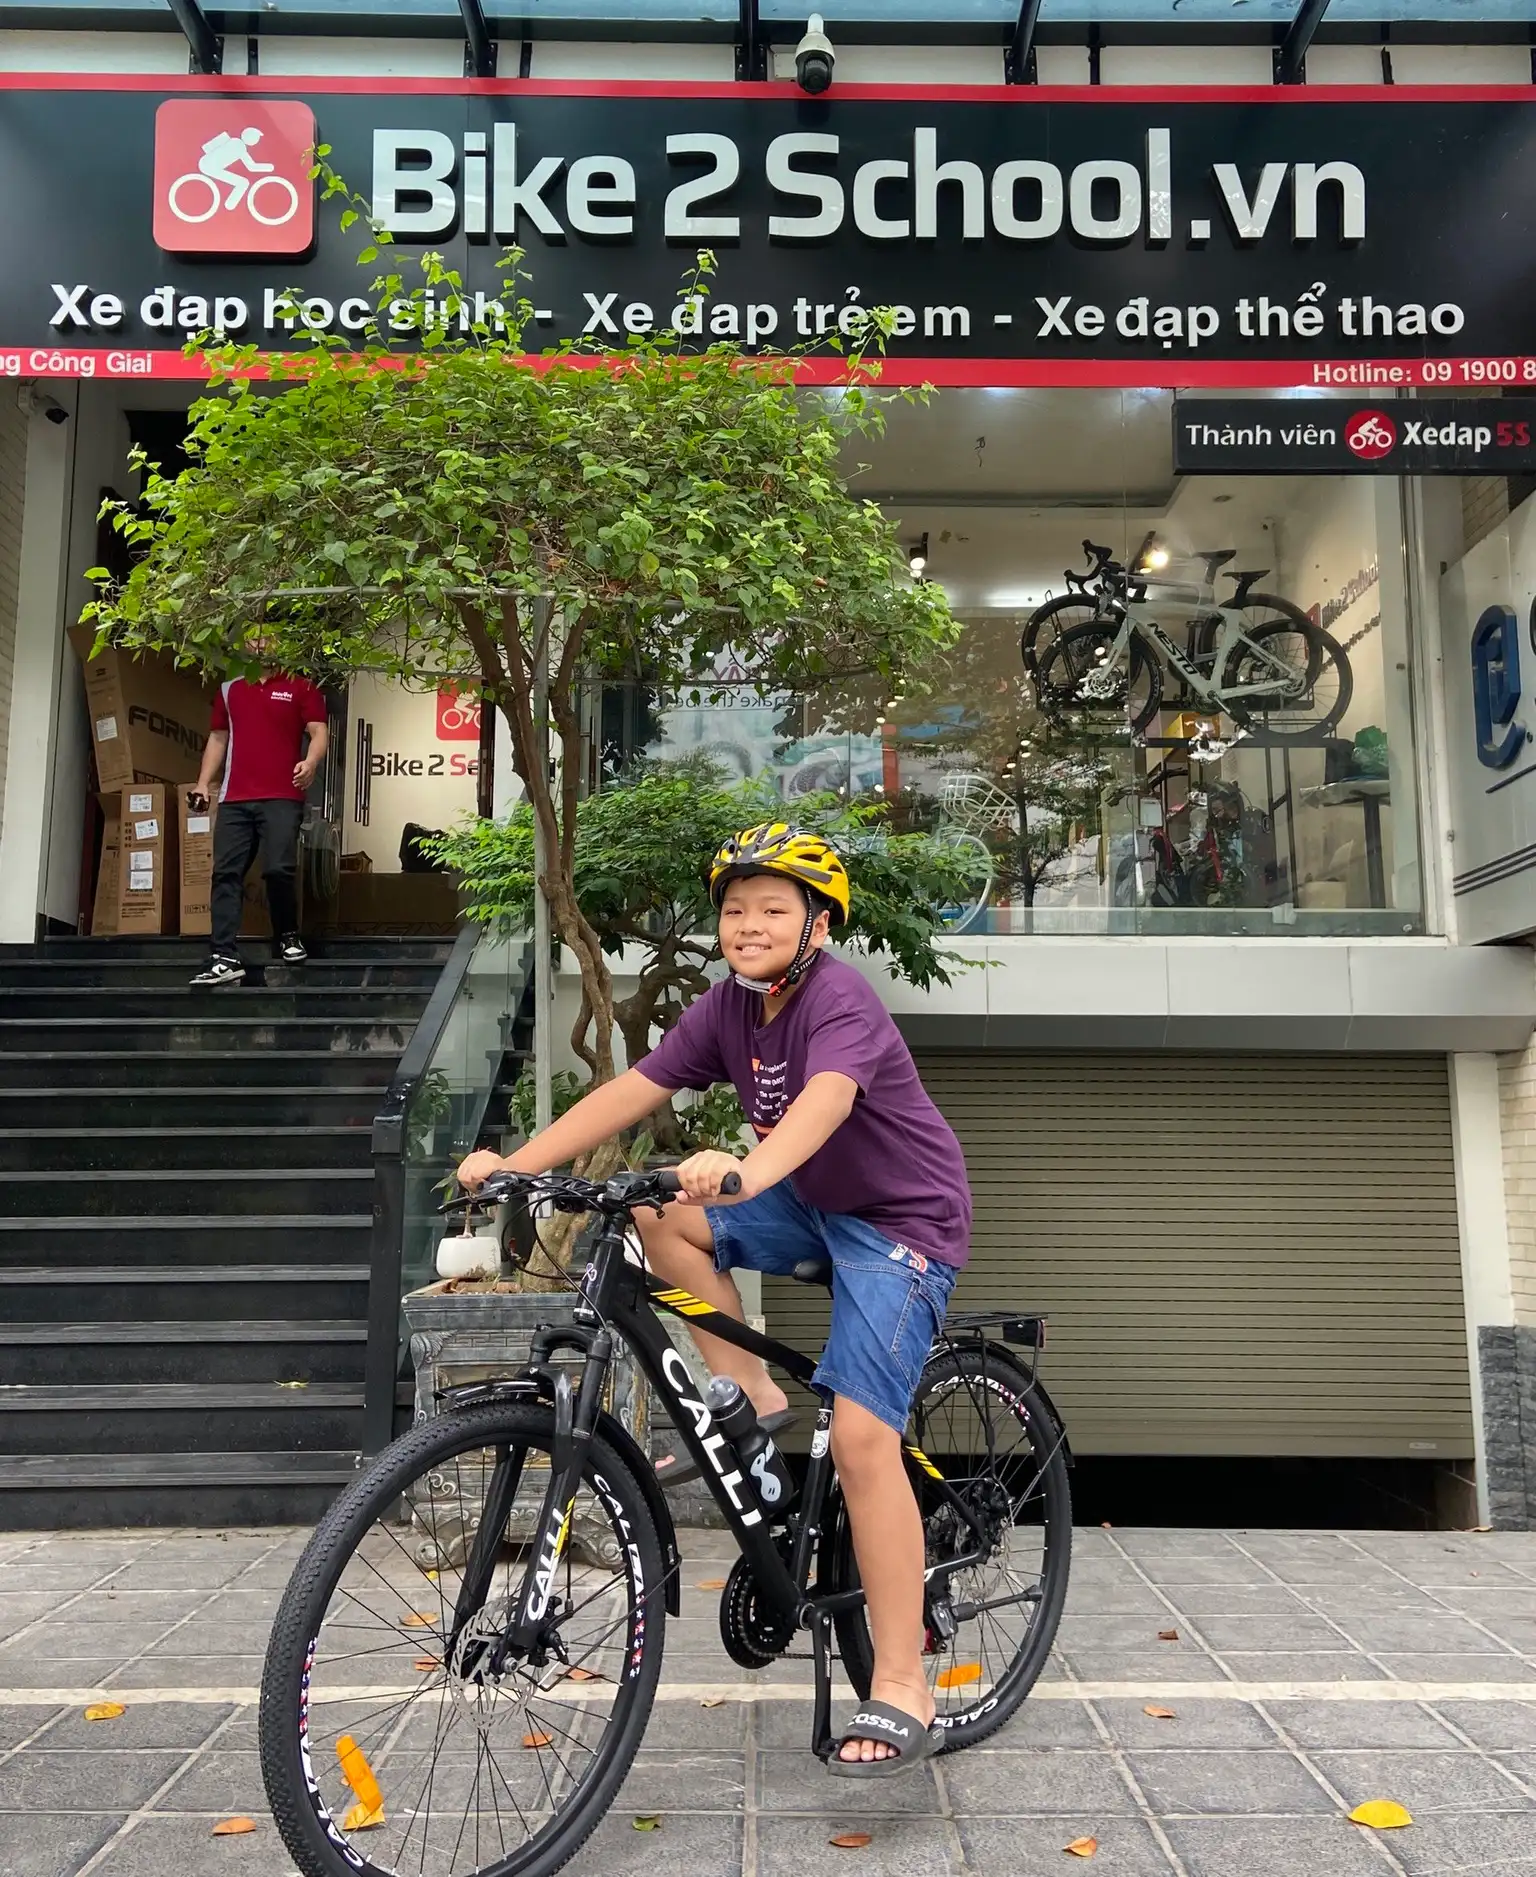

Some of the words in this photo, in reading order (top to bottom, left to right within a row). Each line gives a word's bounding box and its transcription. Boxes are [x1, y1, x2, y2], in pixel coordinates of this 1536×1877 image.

[372, 122, 636, 235] Bike
[664, 133, 741, 237] 2
[765, 127, 1366, 240] School.vn
[49, 284, 123, 327] Xe
[141, 285, 248, 340] đạp
[388, 287, 506, 332] sinh
[582, 292, 653, 333] Xe
[794, 286, 869, 337] trẻ
[886, 304, 970, 336] em
[1033, 296, 1106, 337] Xe
[1115, 297, 1220, 349] đạp
[1234, 281, 1327, 337] thể
[1337, 296, 1465, 336] thao
[29, 350, 96, 378] Công
[106, 352, 153, 373] Giai
[1313, 362, 1412, 384] Hotline:
[1421, 361, 1453, 382] 09
[1458, 360, 1517, 381] 1900
[1185, 424, 1272, 446] Thành
[1279, 424, 1337, 446] viên
[1402, 421, 1492, 452] Xedap
[1496, 422, 1531, 447] 5S
[1147, 622, 1199, 675] NESTO
[369, 752, 424, 776] Bike
[427, 754, 445, 776] 2
[661, 1347, 763, 1527] CALLI
[593, 1473, 645, 1595] CALLI
[527, 1507, 565, 1622] CALLI
[931, 1697, 999, 1728] CALL
